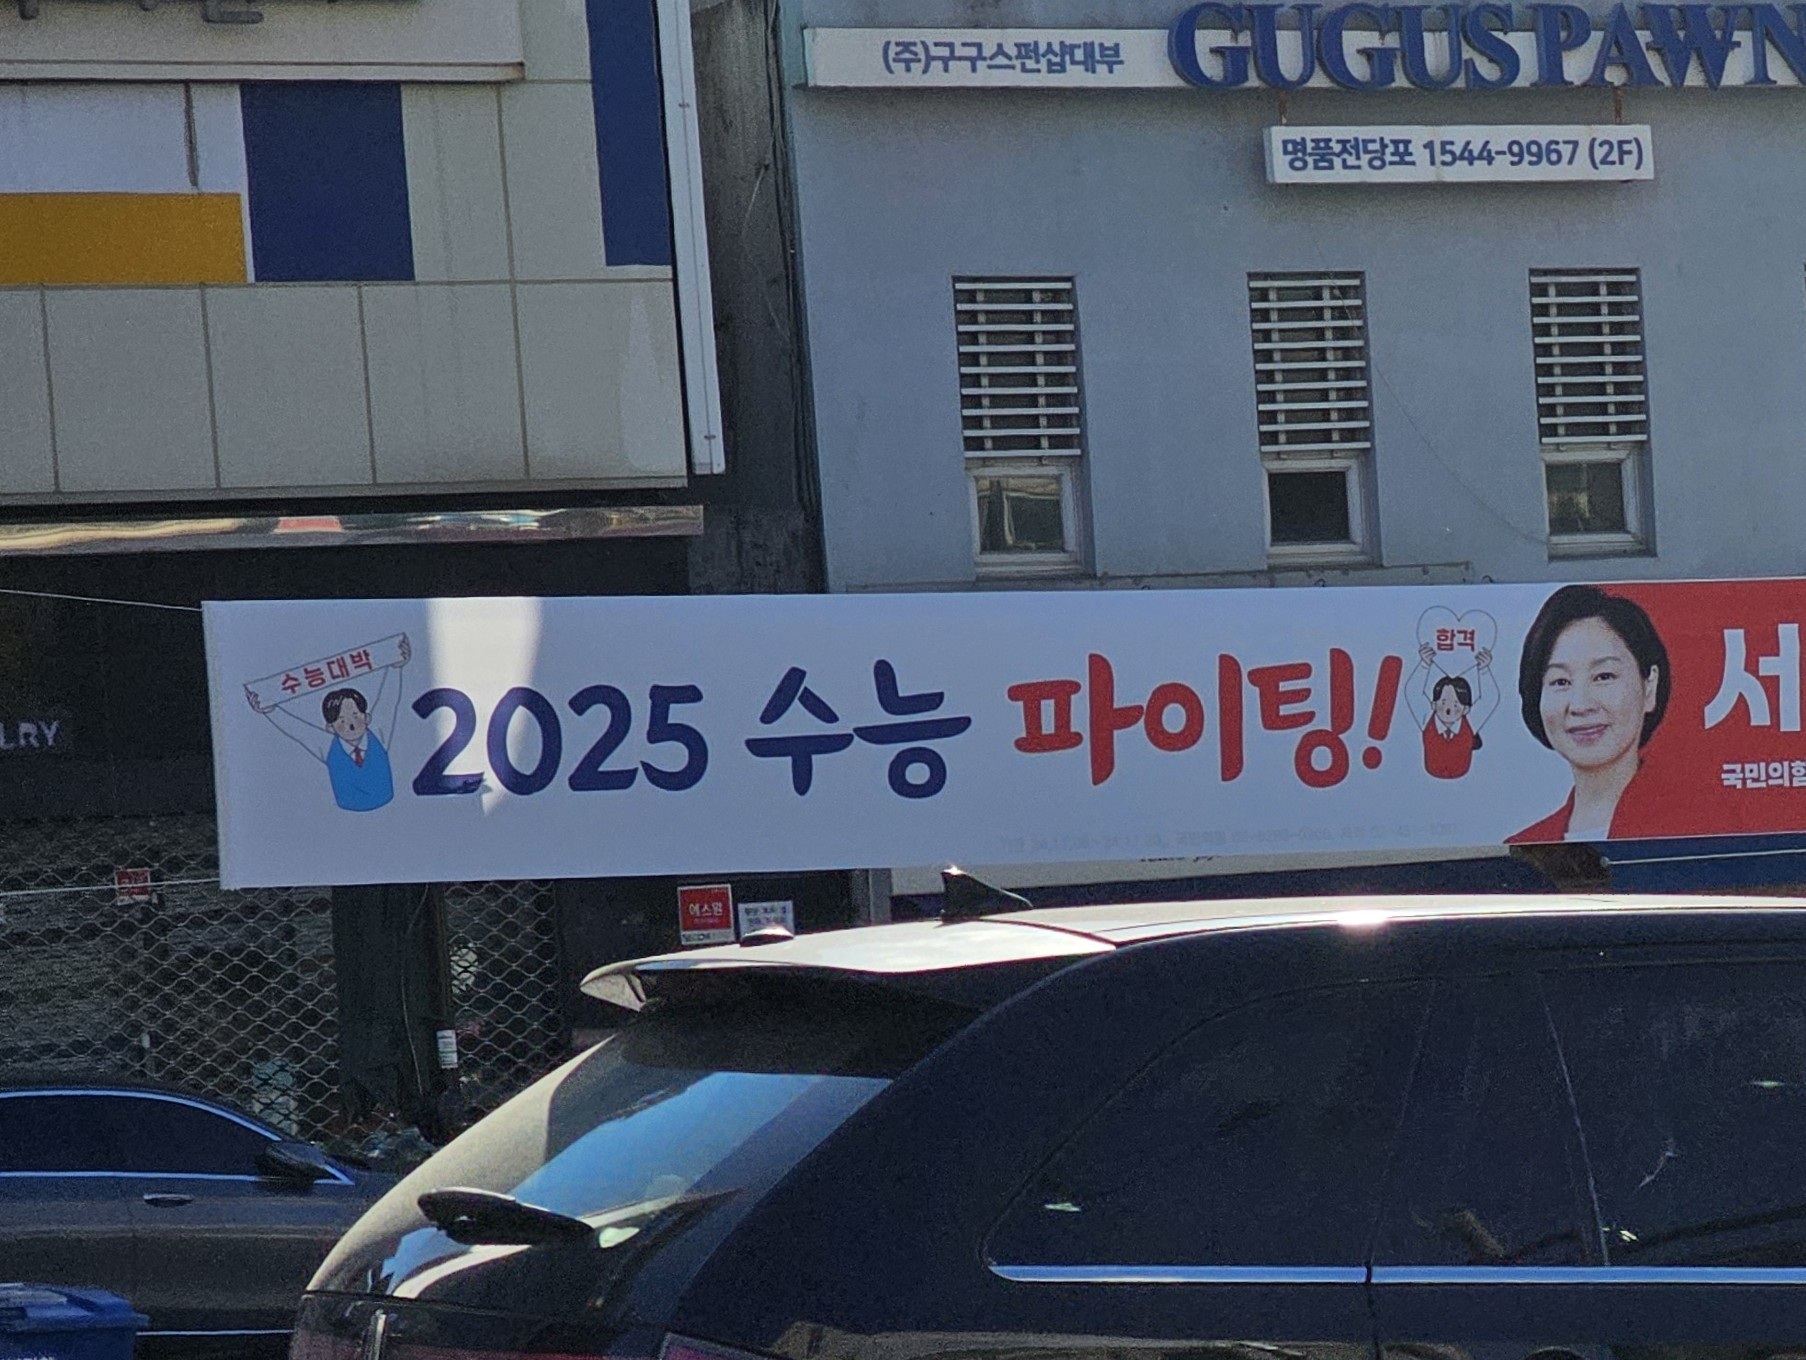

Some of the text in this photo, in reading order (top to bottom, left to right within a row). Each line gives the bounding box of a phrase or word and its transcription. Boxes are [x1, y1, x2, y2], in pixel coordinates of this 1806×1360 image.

[1167, 2, 1521, 92] GUGUS
[1280, 135, 1645, 172] 명품전당포 1544-9967 (2F)
[1436, 628, 1476, 653] 합격
[281, 649, 374, 694] 수능대박
[411, 647, 1404, 800] 2025 수능 파이팅!
